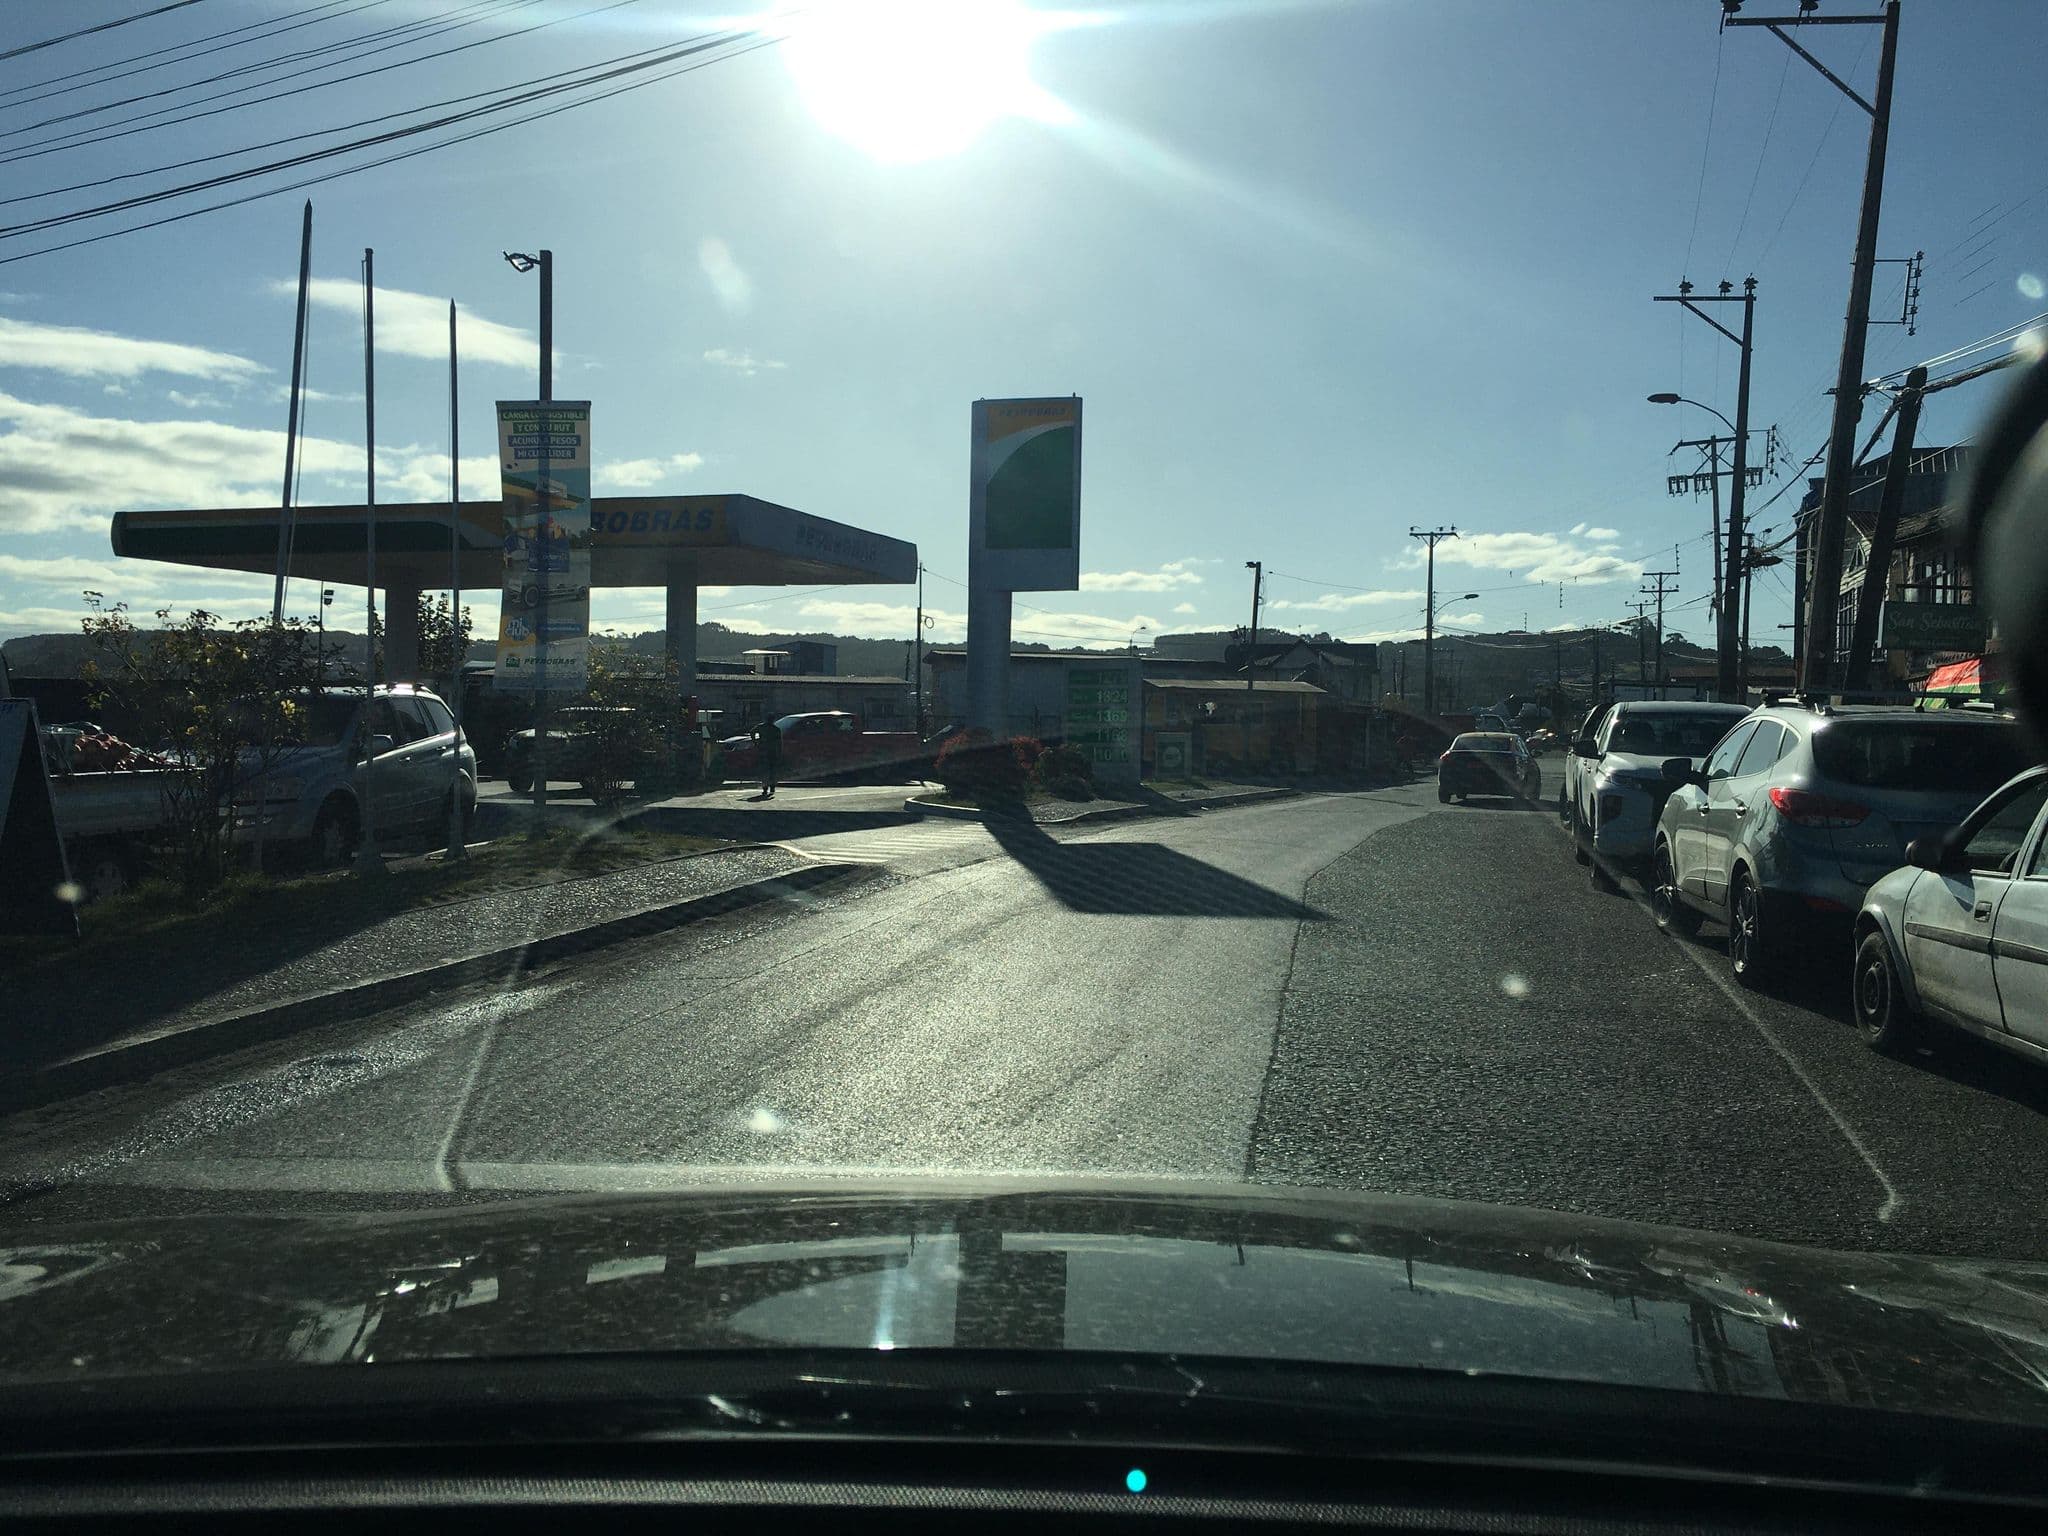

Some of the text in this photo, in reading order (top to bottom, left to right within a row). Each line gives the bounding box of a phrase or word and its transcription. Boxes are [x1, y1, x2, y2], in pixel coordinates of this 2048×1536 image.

[530, 410, 584, 420] COUSTIBLE
[511, 436, 577, 445] ACUMU PESOS
[548, 448, 572, 458] LIDER
[591, 507, 714, 533] ROBRAS
[523, 656, 577, 665] PETROBRAS
